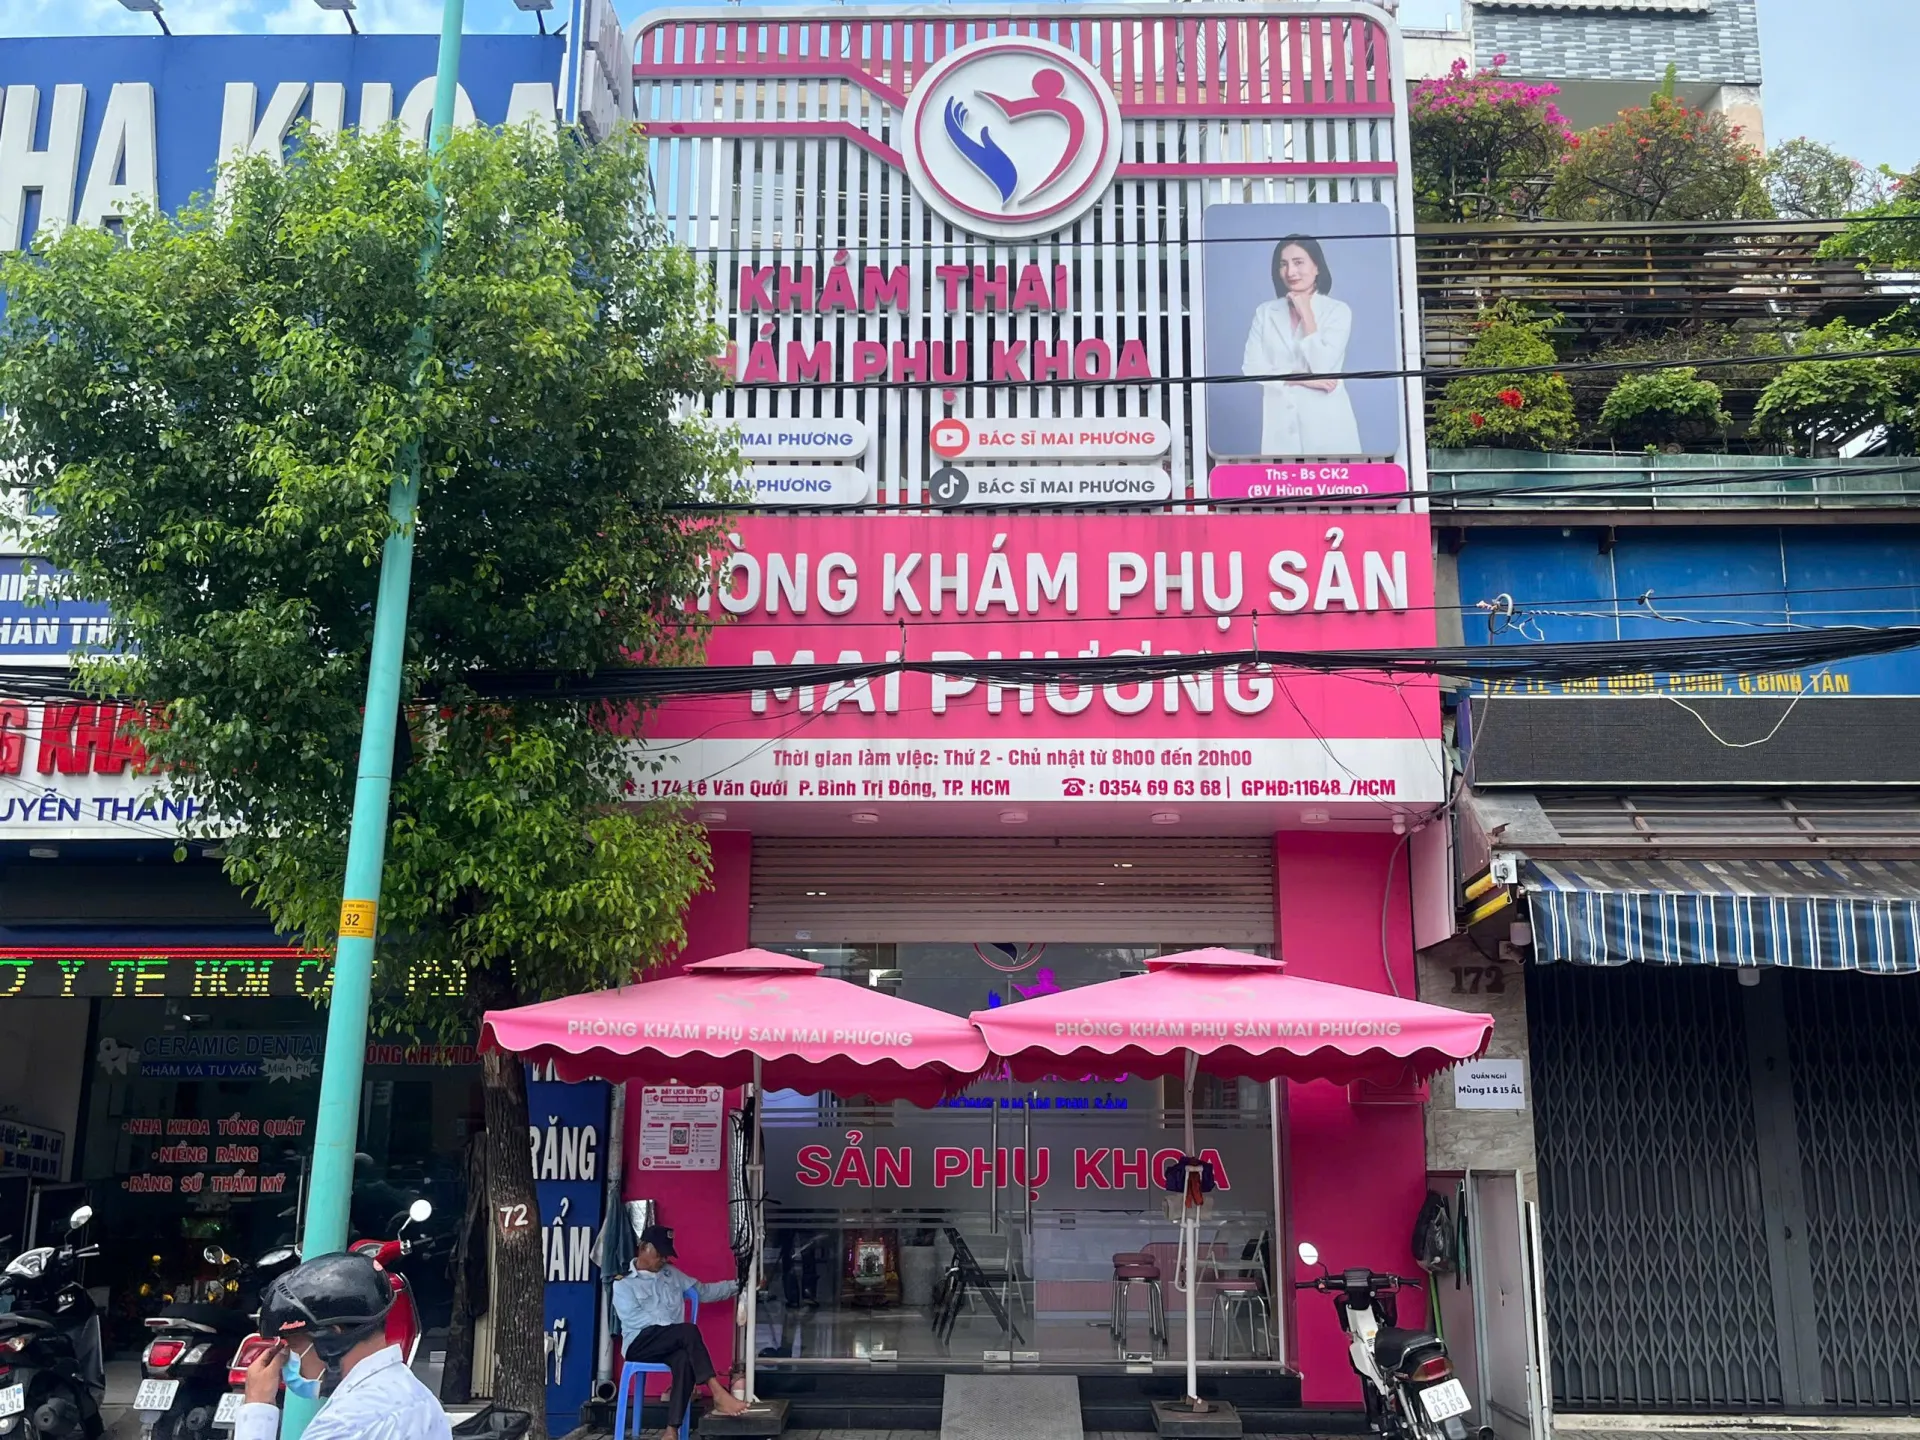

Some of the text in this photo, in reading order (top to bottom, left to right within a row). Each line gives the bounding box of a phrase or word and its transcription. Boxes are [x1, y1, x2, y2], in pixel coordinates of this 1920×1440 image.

[0, 82, 160, 252] HA
[738, 250, 1069, 314] KHÁM THAI
[706, 322, 1153, 406] HÁM PHỤ KHOA
[739, 432, 773, 446] MAI
[777, 431, 854, 446] PHƯƠNG
[978, 430, 1156, 446] BÁC SĨ MAI PHƯƠNG
[756, 478, 832, 493] PHƯƠNG
[977, 477, 1156, 495] BÁC SĨ MAI PHƯƠNG
[1265, 468, 1289, 481] Ths
[1300, 468, 1316, 480] Bs
[1320, 468, 1349, 480] CK2
[1248, 485, 1271, 499] (BV
[882, 533, 1078, 616] KHÁM
[1108, 550, 1244, 633] PHỤ
[1268, 526, 1409, 614] SẢN
[750, 639, 1276, 716] MAI PHƯƠNG
[1810, 670, 1851, 693] TÂN
[772, 748, 809, 766] Thời
[814, 749, 853, 768] gian
[858, 748, 891, 766] làm
[896, 749, 939, 769] việc:
[943, 748, 976, 766] Thứ
[979, 749, 991, 766] 2
[1009, 747, 1042, 766] Chủ
[1046, 747, 1086, 767] nhật
[1090, 748, 1108, 766] từ
[1112, 748, 1156, 766] 8h00
[1160, 747, 1193, 766] đến
[1198, 749, 1253, 766] 20h00
[651, 779, 683, 797] 174
[688, 779, 708, 796] Lê
[713, 779, 745, 796] Văn
[750, 778, 789, 798] Quới
[818, 778, 857, 796] Bình
[862, 778, 884, 799] Trị
[888, 777, 936, 799] Đông,
[942, 779, 964, 797] TP.
[970, 779, 1011, 796] HCM
[1099, 778, 1142, 796] 0354
[1146, 778, 1169, 796] 69
[1173, 778, 1195, 796] 63
[1199, 778, 1221, 796] 68
[344, 912, 361, 927] 32
[1450, 965, 1506, 994] 172
[566, 1018, 638, 1038] PHÒNG
[643, 1021, 701, 1040] KHÁM
[705, 1025, 744, 1045] PHỤ
[791, 1029, 828, 1044] MAI
[832, 1029, 914, 1048] PHƯƠNG
[1054, 1017, 1125, 1037] PHÒNG
[1129, 1018, 1186, 1037] KHÁM
[1190, 1022, 1229, 1042] PHỤ
[1276, 1021, 1313, 1038] MAI
[1318, 1021, 1402, 1037] PHƯƠNG
[143, 1034, 326, 1057] CERAMIC DENTAL
[365, 1039, 404, 1066] ÒNG
[141, 1060, 258, 1077] KHÁM VÀ TƯ VẤN
[1458, 1082, 1523, 1096] Mùng 1 & 15 ÂL
[130, 1111, 306, 1138] NHA KHOA TỔNG QUÁT
[159, 1140, 259, 1163] NIỀNG RĂNG
[529, 1115, 597, 1181] RĂNG
[796, 1130, 913, 1188] SẢN
[933, 1146, 1051, 1202] PHỤ
[129, 1168, 287, 1193] RĂNG SỨ THẨM MỸ
[500, 1203, 529, 1228] 72
